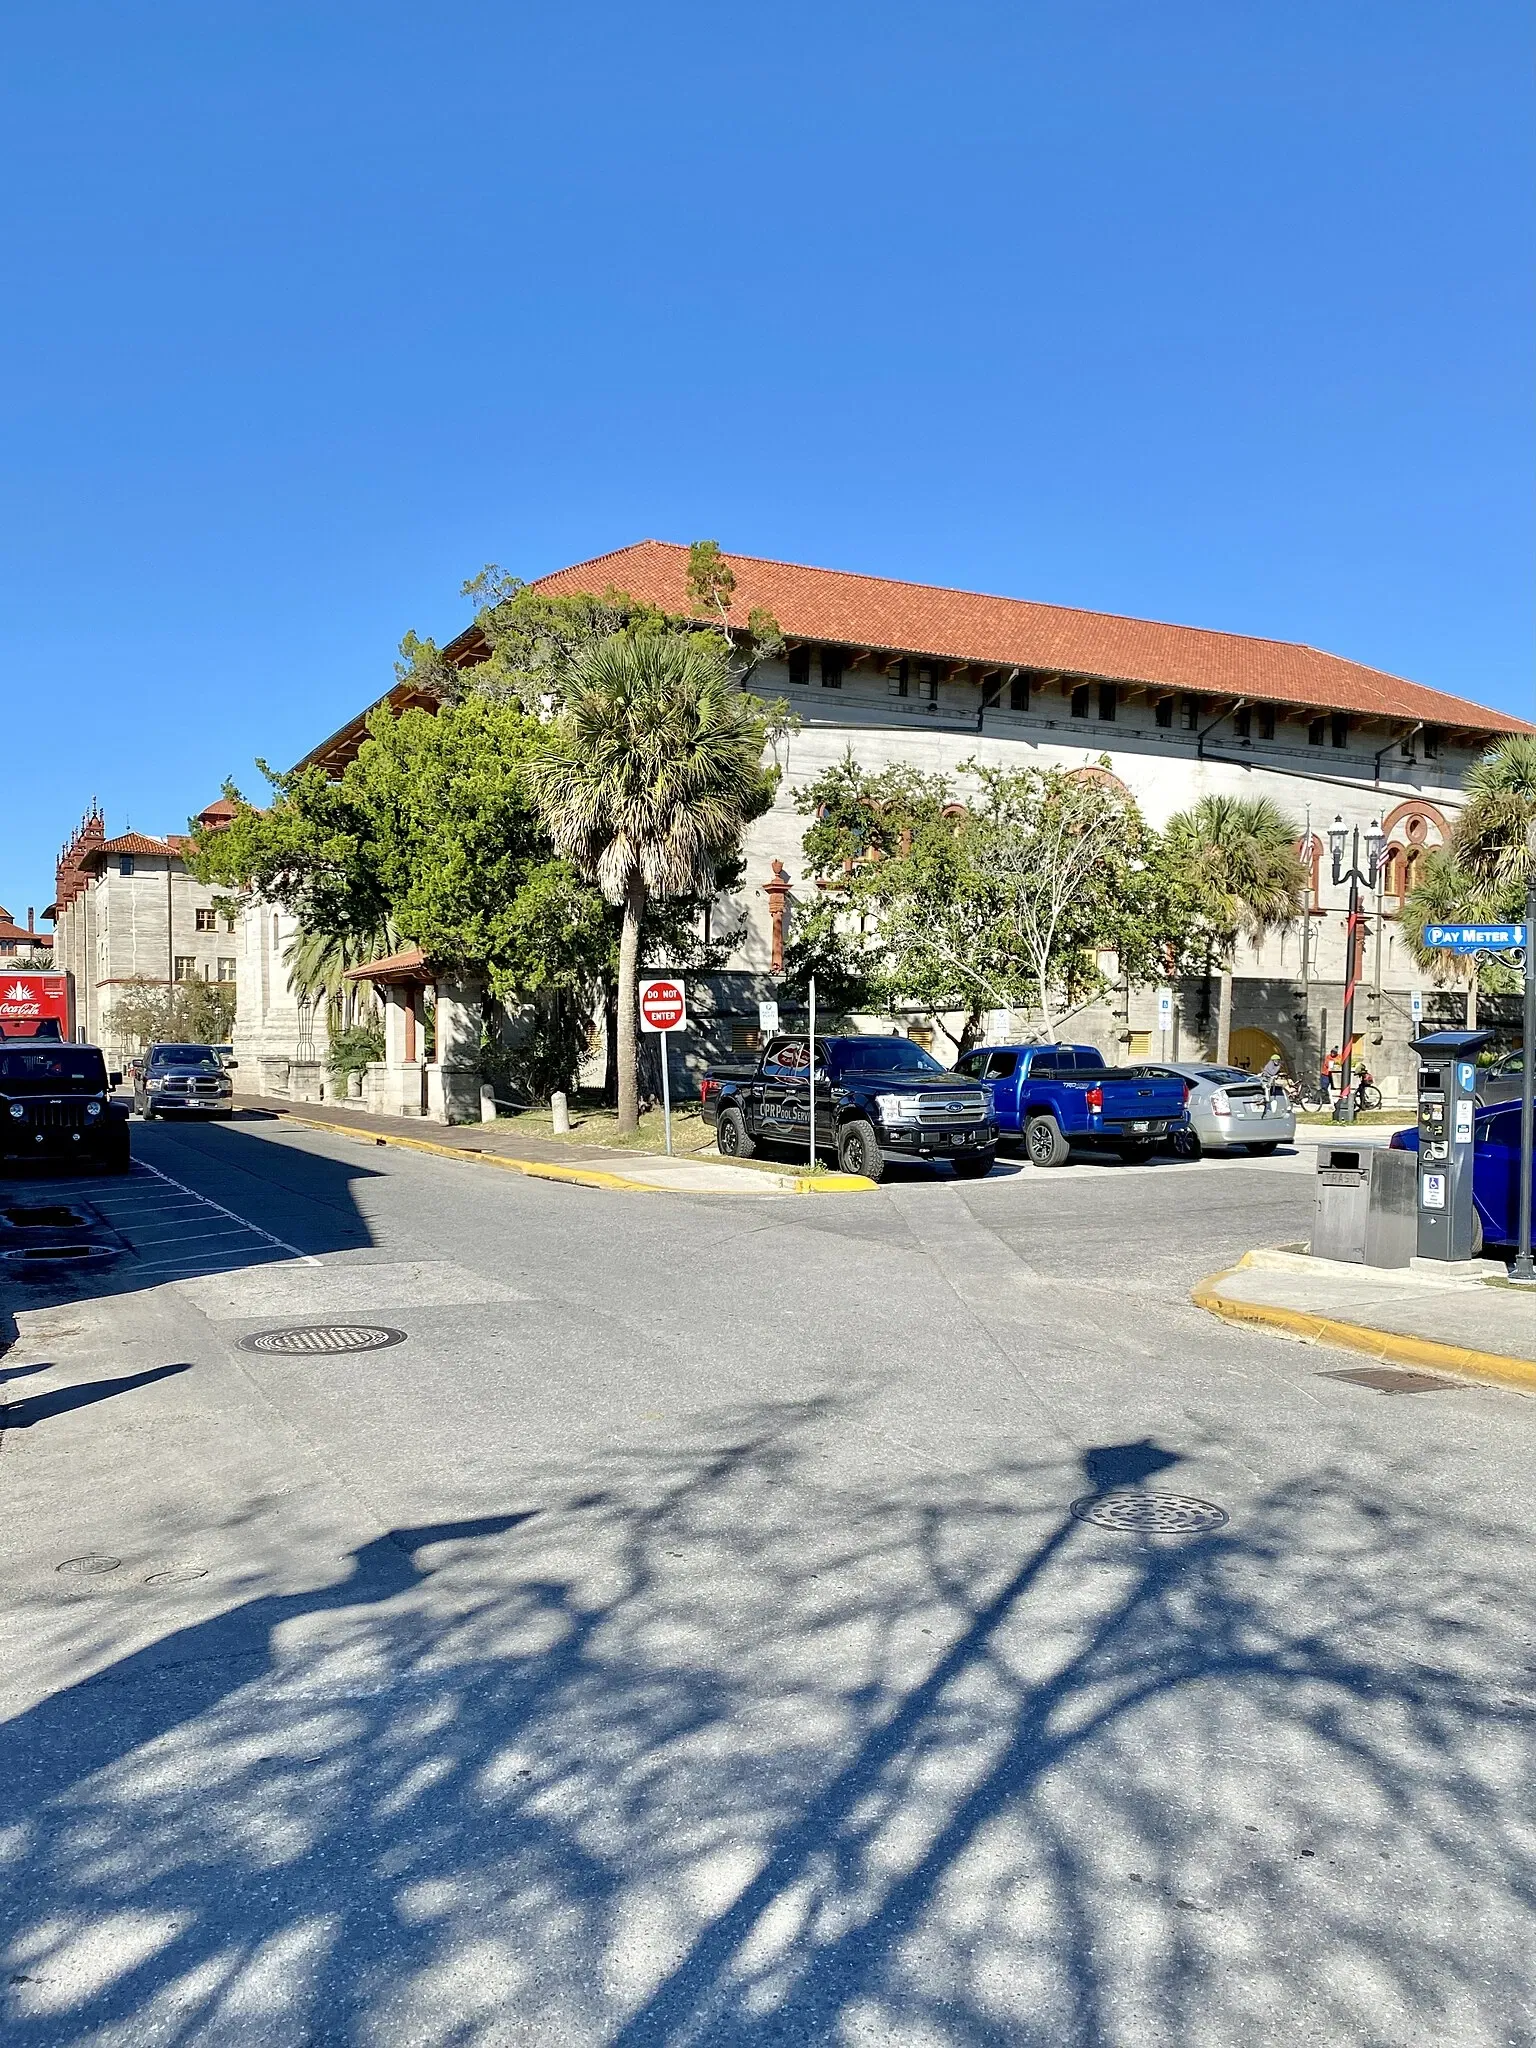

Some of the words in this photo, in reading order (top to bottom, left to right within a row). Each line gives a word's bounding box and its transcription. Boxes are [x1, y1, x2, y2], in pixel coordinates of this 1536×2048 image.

[1432, 929, 1460, 943] PAY
[1463, 930, 1509, 943] METER
[647, 990, 659, 999] DO
[663, 989, 678, 998] NOT
[652, 1012, 676, 1021] ENTER
[1461, 1065, 1473, 1087] P
[792, 1106, 818, 1122] SERVIE
